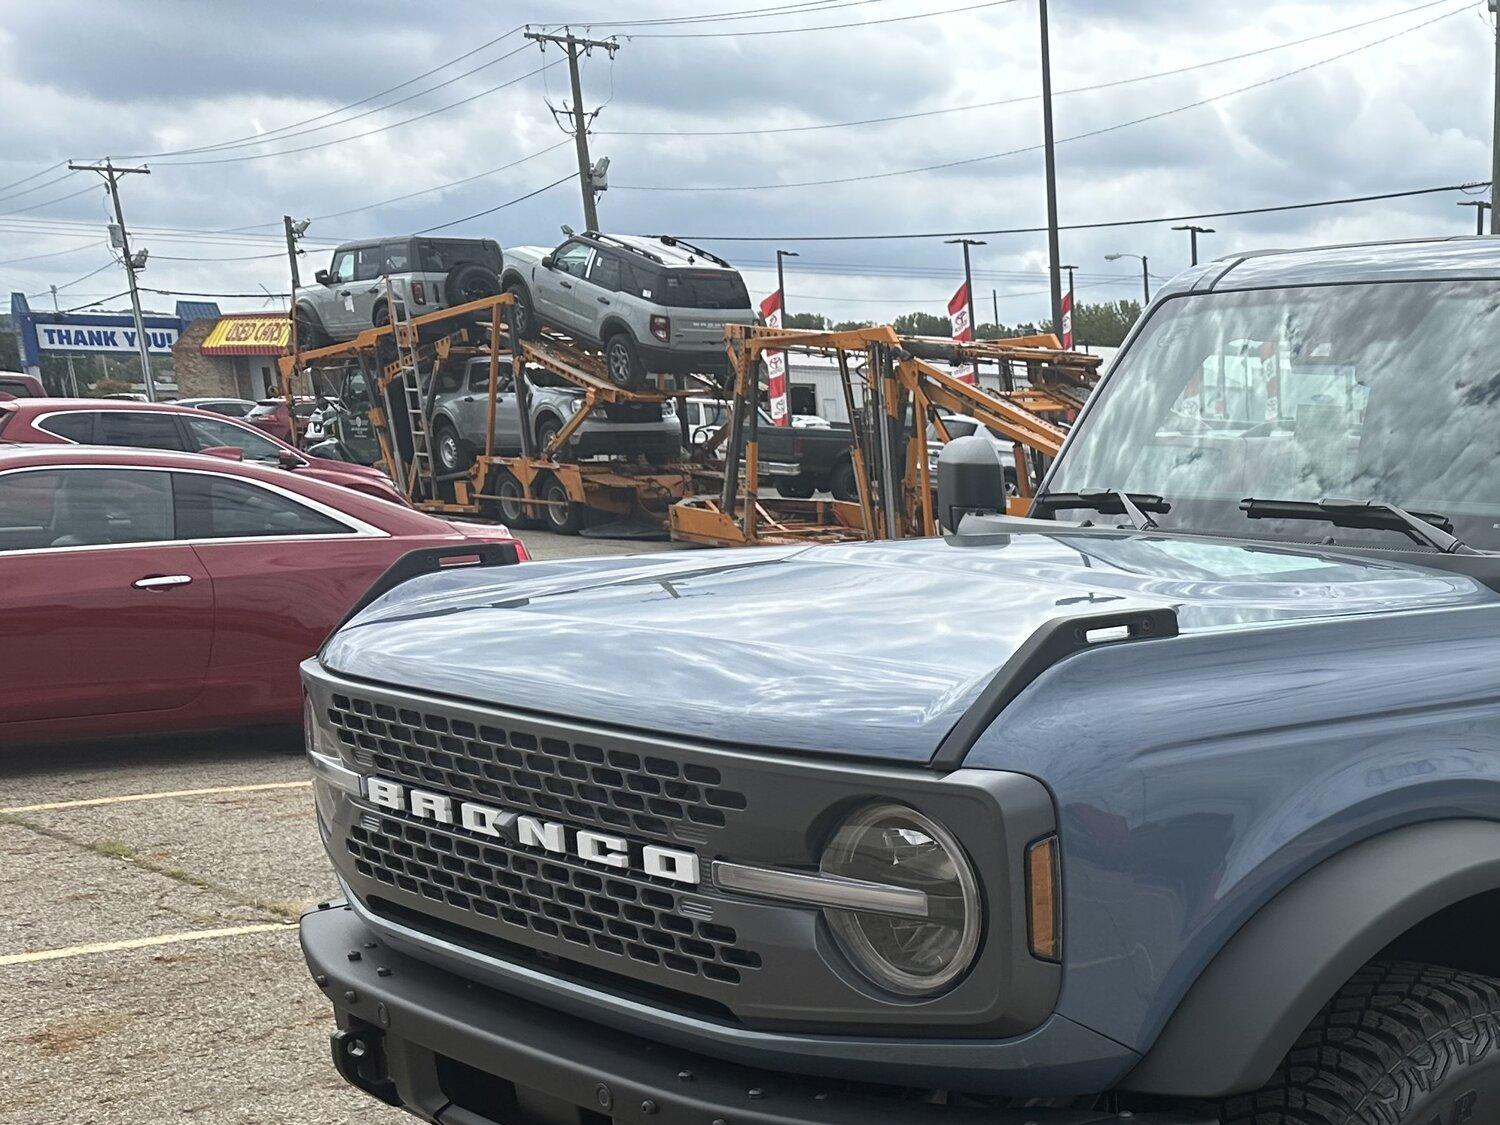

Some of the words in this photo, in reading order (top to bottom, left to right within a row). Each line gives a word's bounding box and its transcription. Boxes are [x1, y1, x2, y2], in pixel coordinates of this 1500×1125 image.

[43, 328, 117, 348] THANK
[226, 322, 257, 341] USED
[254, 322, 287, 342] CARS
[367, 777, 700, 885] BRONCO
